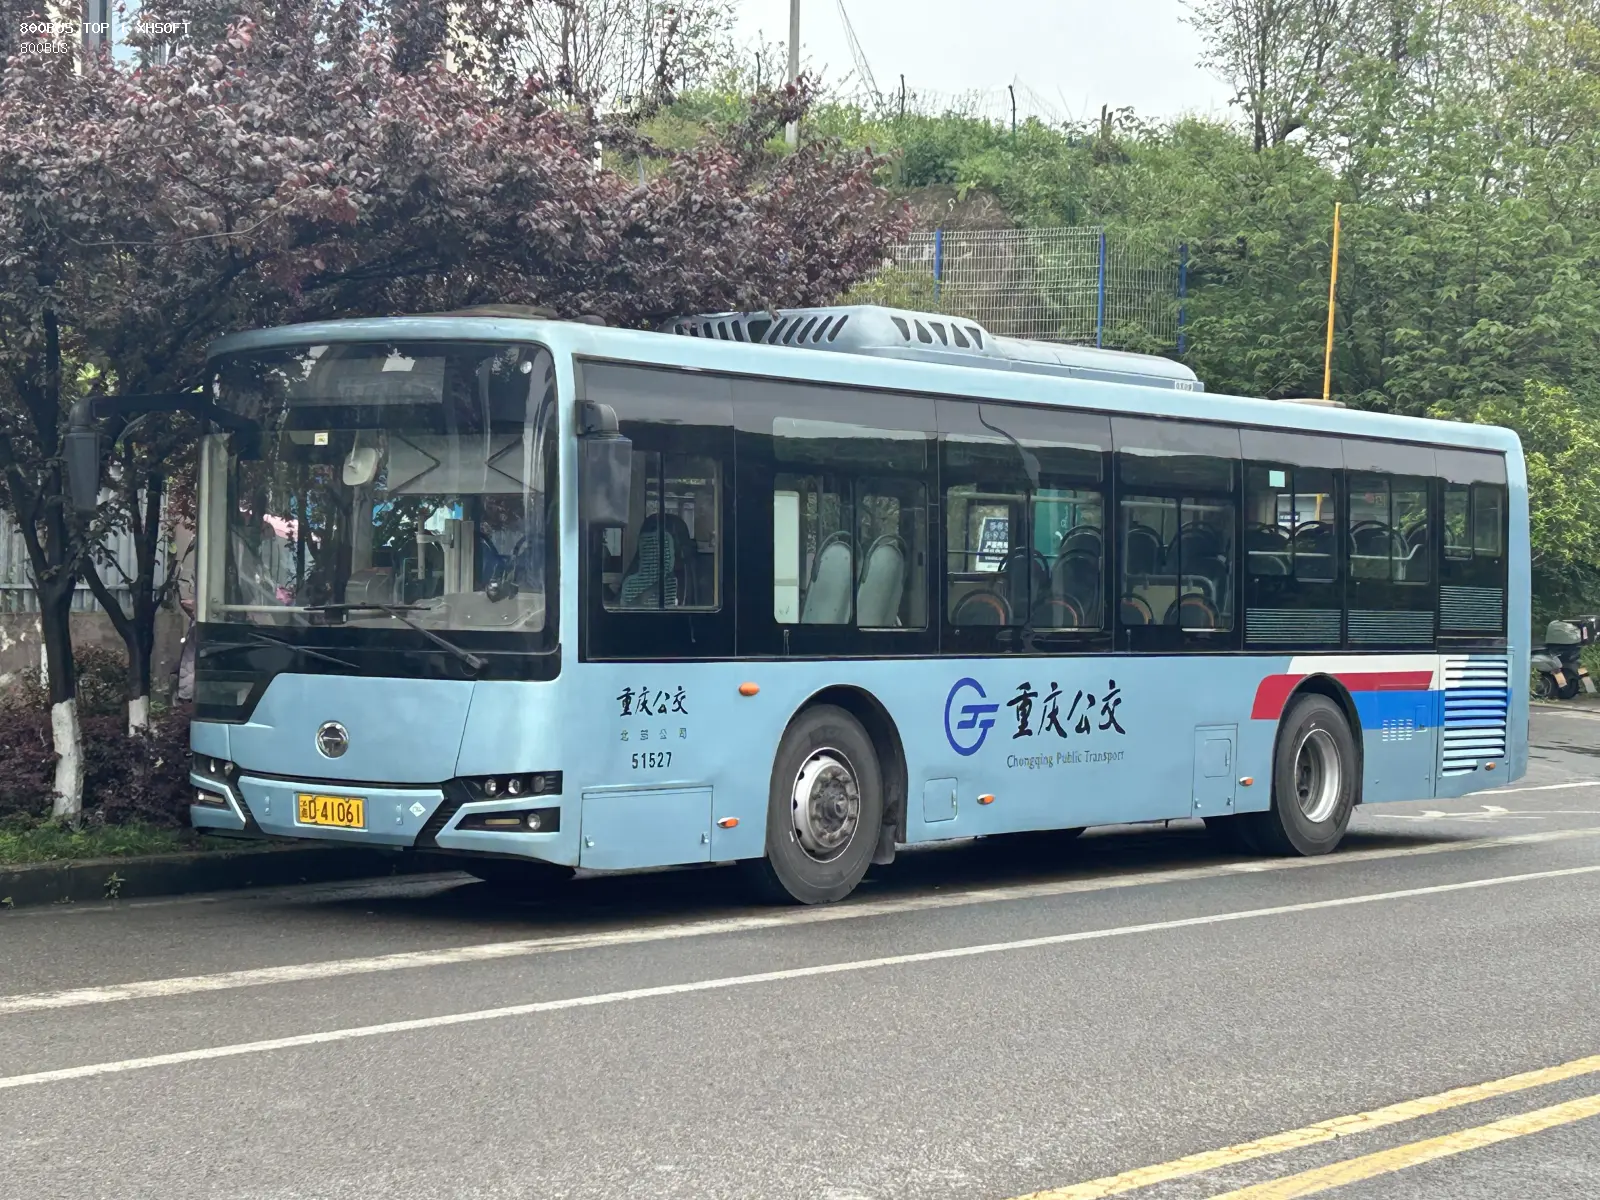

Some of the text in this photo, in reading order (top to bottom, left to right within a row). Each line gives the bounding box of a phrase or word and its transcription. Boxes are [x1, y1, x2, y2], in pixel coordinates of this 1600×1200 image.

[616, 685, 689, 717] 重庆公交
[1006, 679, 1126, 740] 重庆公交
[631, 751, 673, 769] 51527
[1006, 750, 1125, 770] Chongqing Public Transport
